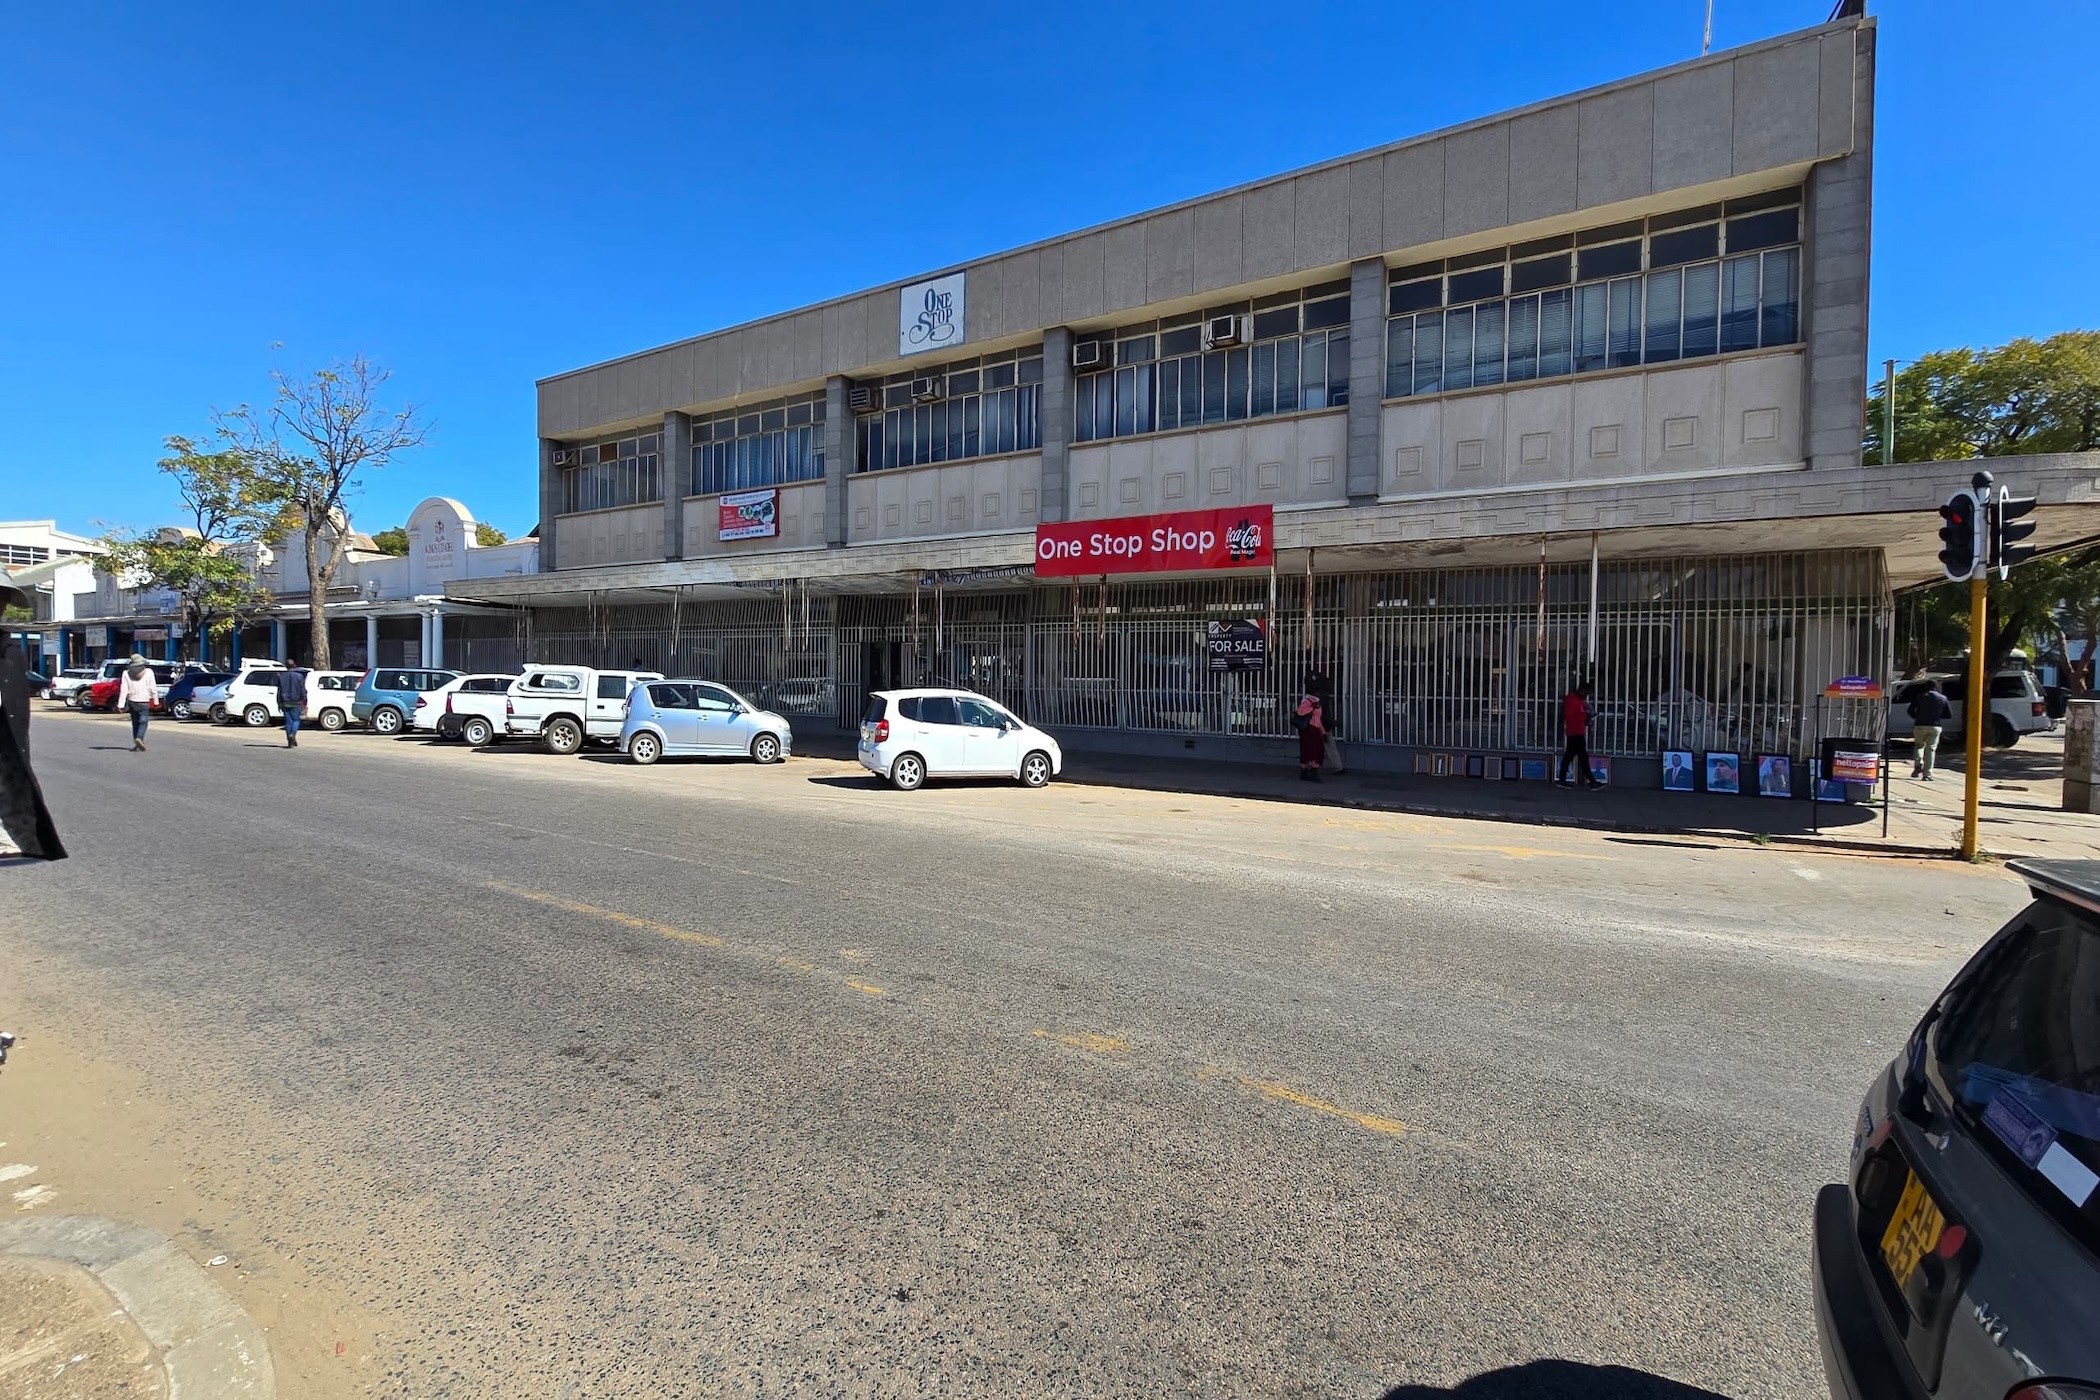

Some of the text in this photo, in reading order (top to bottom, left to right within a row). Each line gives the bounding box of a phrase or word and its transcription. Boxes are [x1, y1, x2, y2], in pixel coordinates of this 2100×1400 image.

[925, 288, 953, 313] ONE
[909, 308, 954, 344] STOP
[1038, 526, 1215, 560] One Stop Shop
[1209, 640, 1264, 653] FOR SALE
